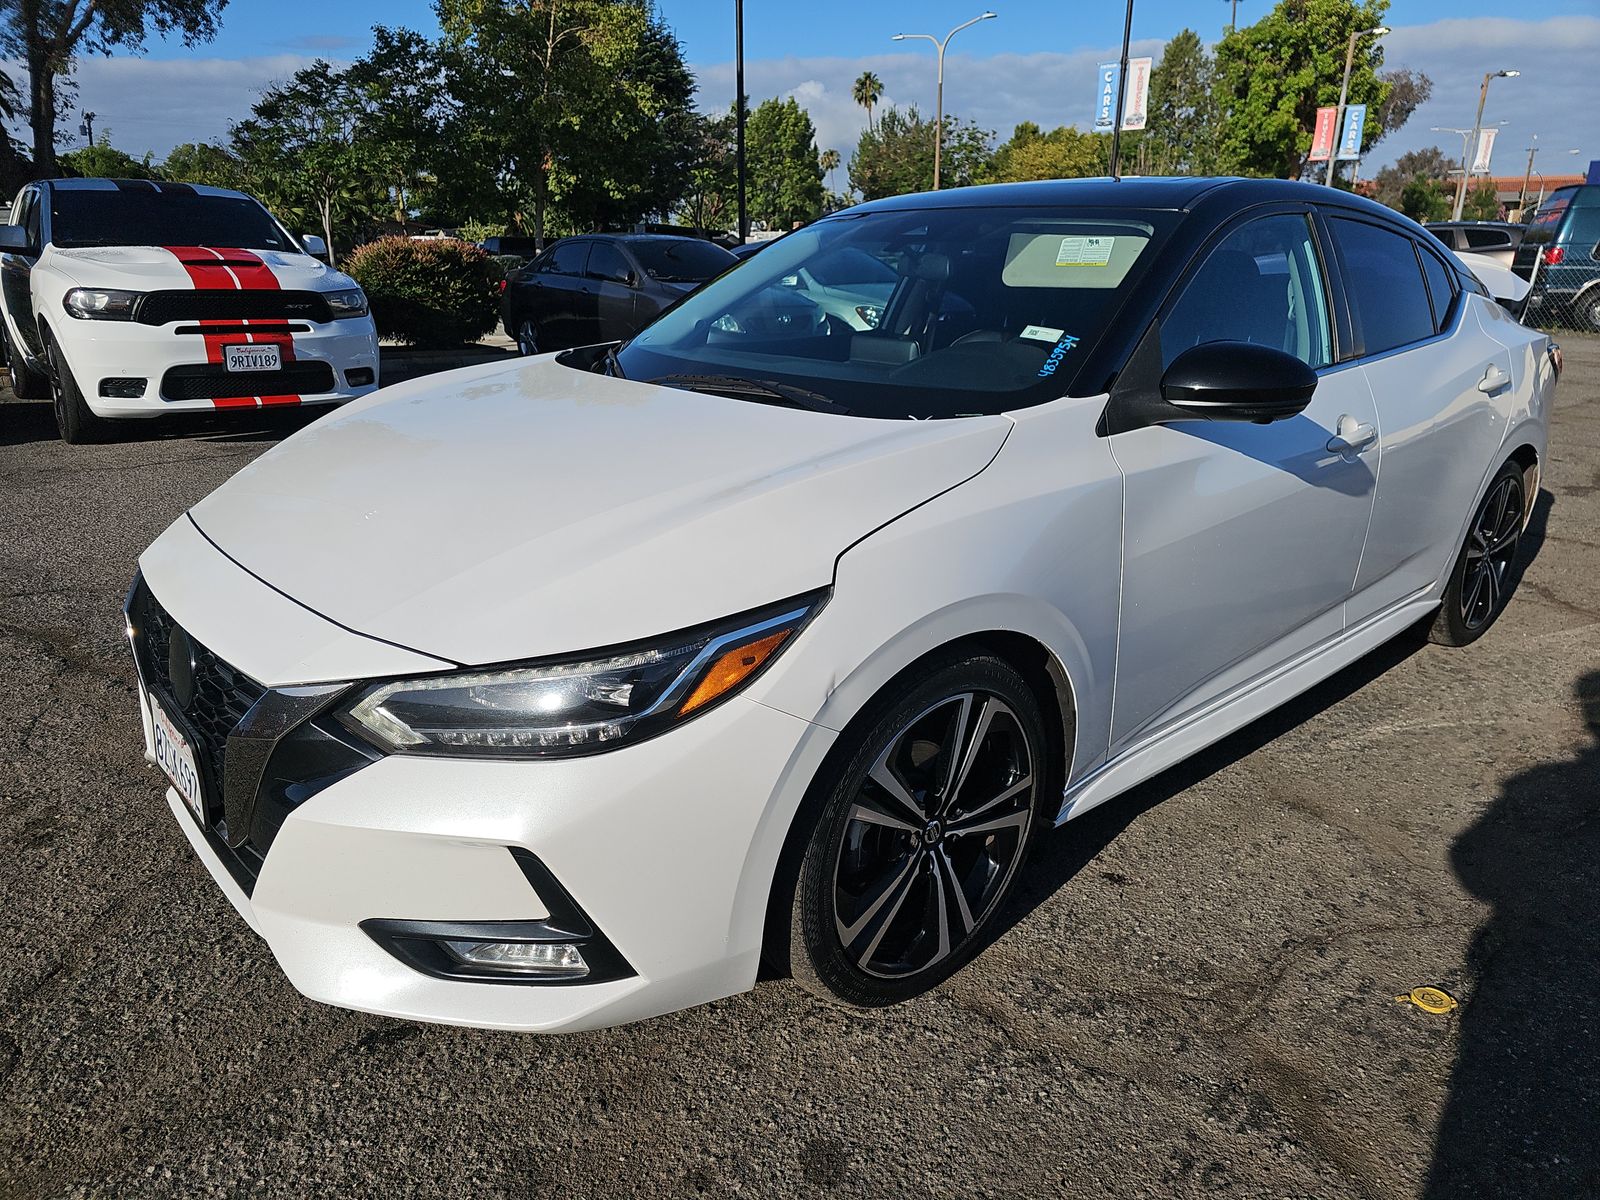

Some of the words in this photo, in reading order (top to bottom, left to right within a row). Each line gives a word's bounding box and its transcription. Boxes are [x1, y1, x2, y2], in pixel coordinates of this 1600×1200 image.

[1101, 71, 1113, 118] CARS
[1346, 111, 1359, 149] CARS
[230, 354, 277, 368] 9RIV189
[1037, 334, 1080, 377] 4835954
